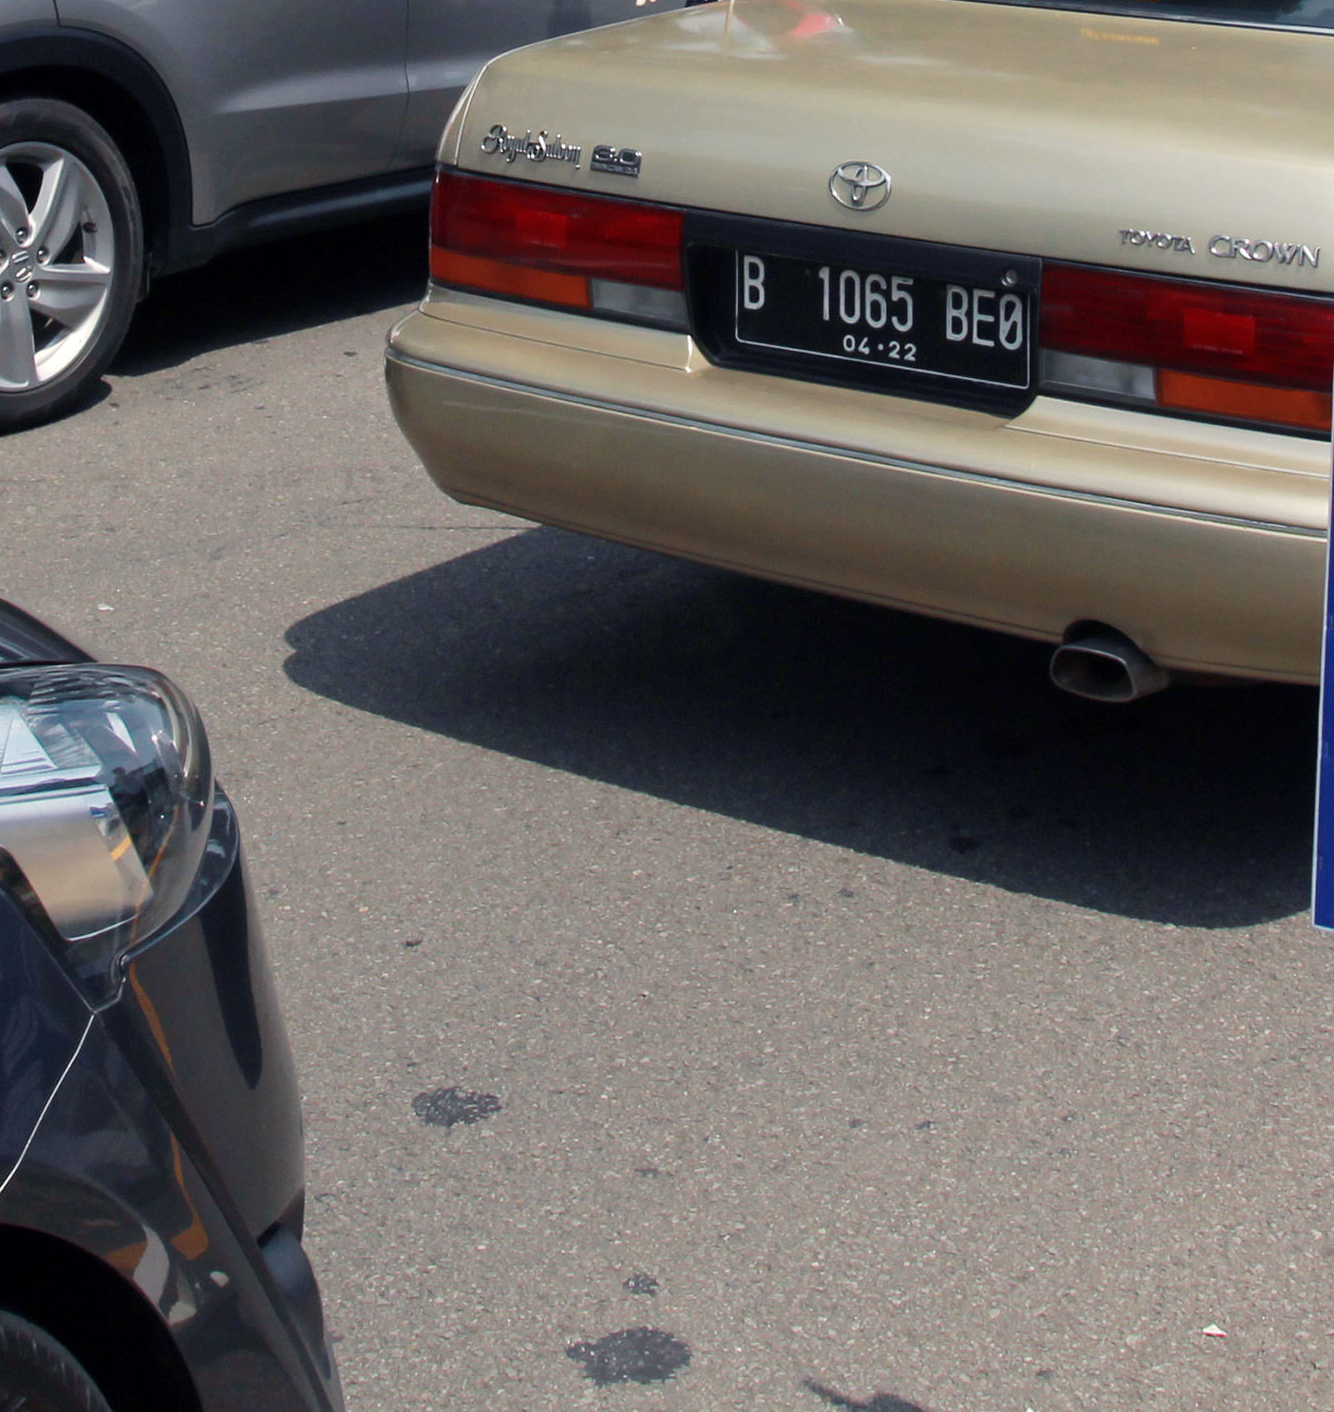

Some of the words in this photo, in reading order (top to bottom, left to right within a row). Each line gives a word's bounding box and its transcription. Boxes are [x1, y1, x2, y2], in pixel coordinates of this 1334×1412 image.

[1119, 228, 1195, 255] TOYOTA
[1208, 234, 1320, 268] CROWN
[743, 255, 765, 310] B
[819, 266, 914, 332] 1065
